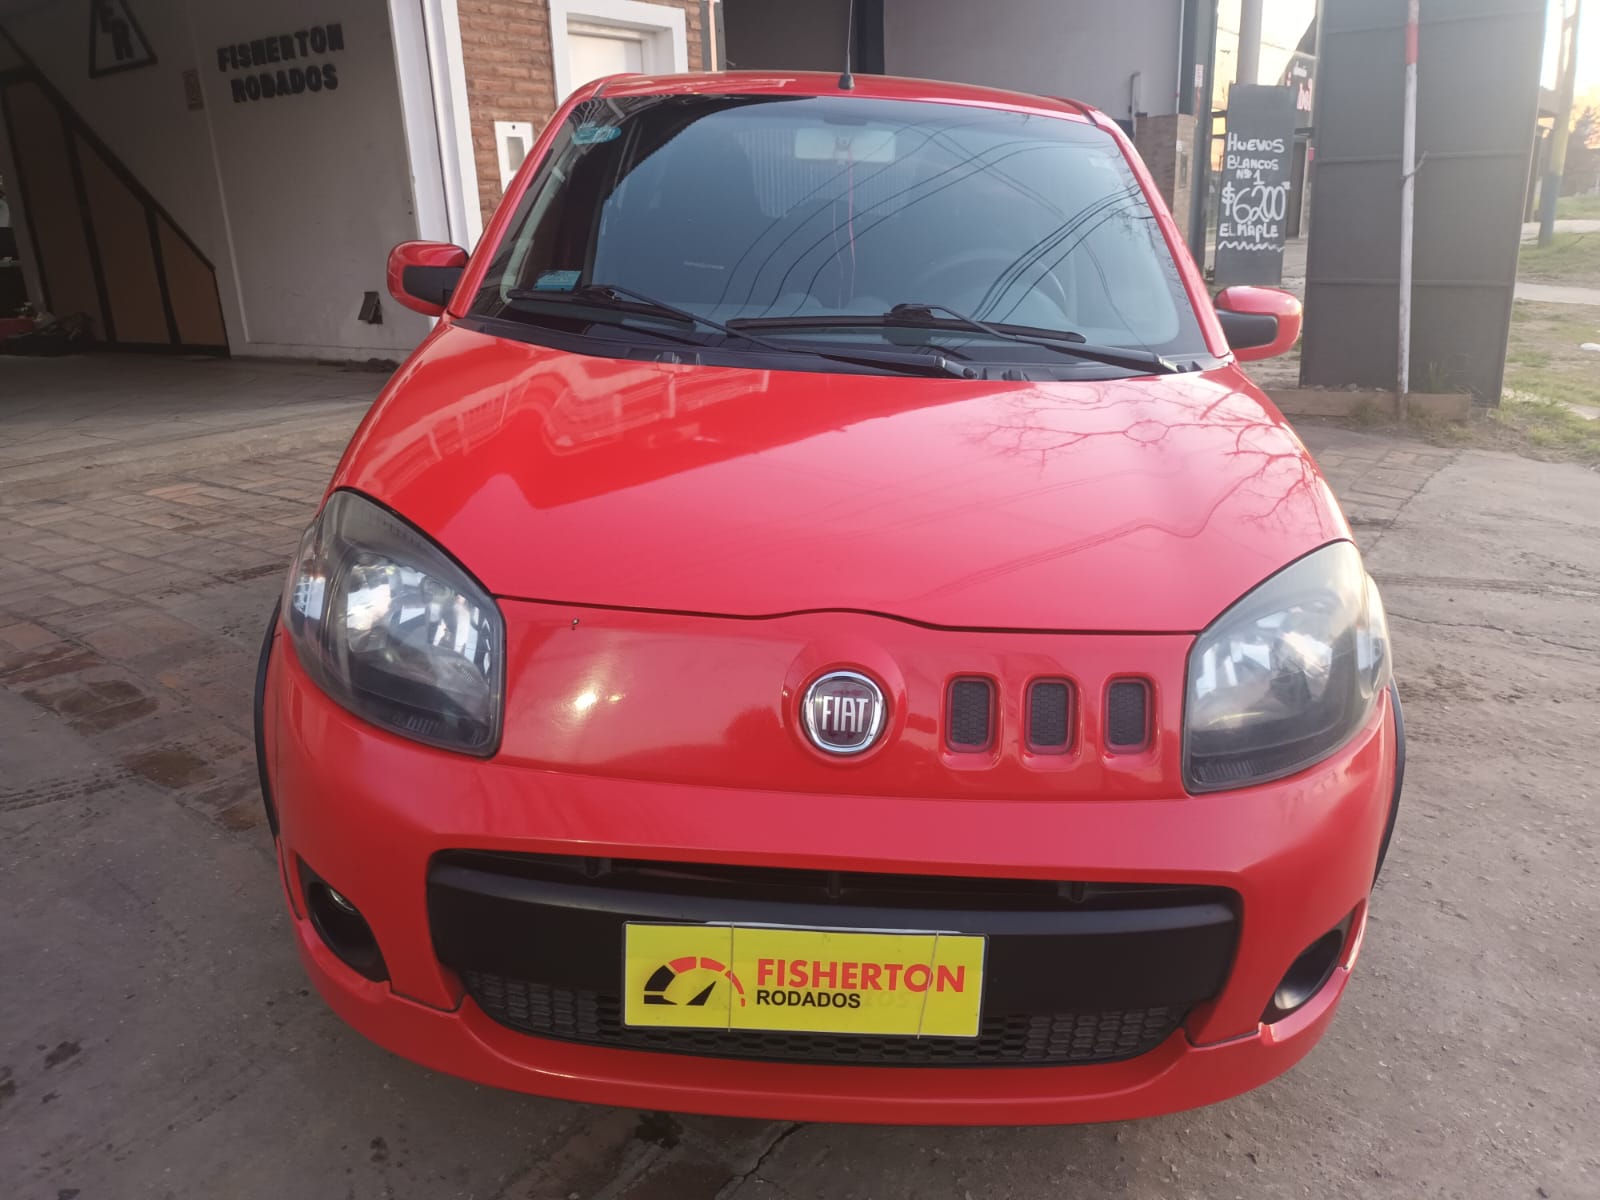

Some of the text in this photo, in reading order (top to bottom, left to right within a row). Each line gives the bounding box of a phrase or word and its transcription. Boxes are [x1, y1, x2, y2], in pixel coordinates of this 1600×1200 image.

[216, 23, 344, 72] FISHERTON
[230, 63, 338, 103] RODADOS
[1226, 155, 1279, 170] BLANCOS
[821, 695, 869, 733] FIAT
[756, 957, 966, 994] FISHERTON
[756, 989, 861, 1009] RODADOS
